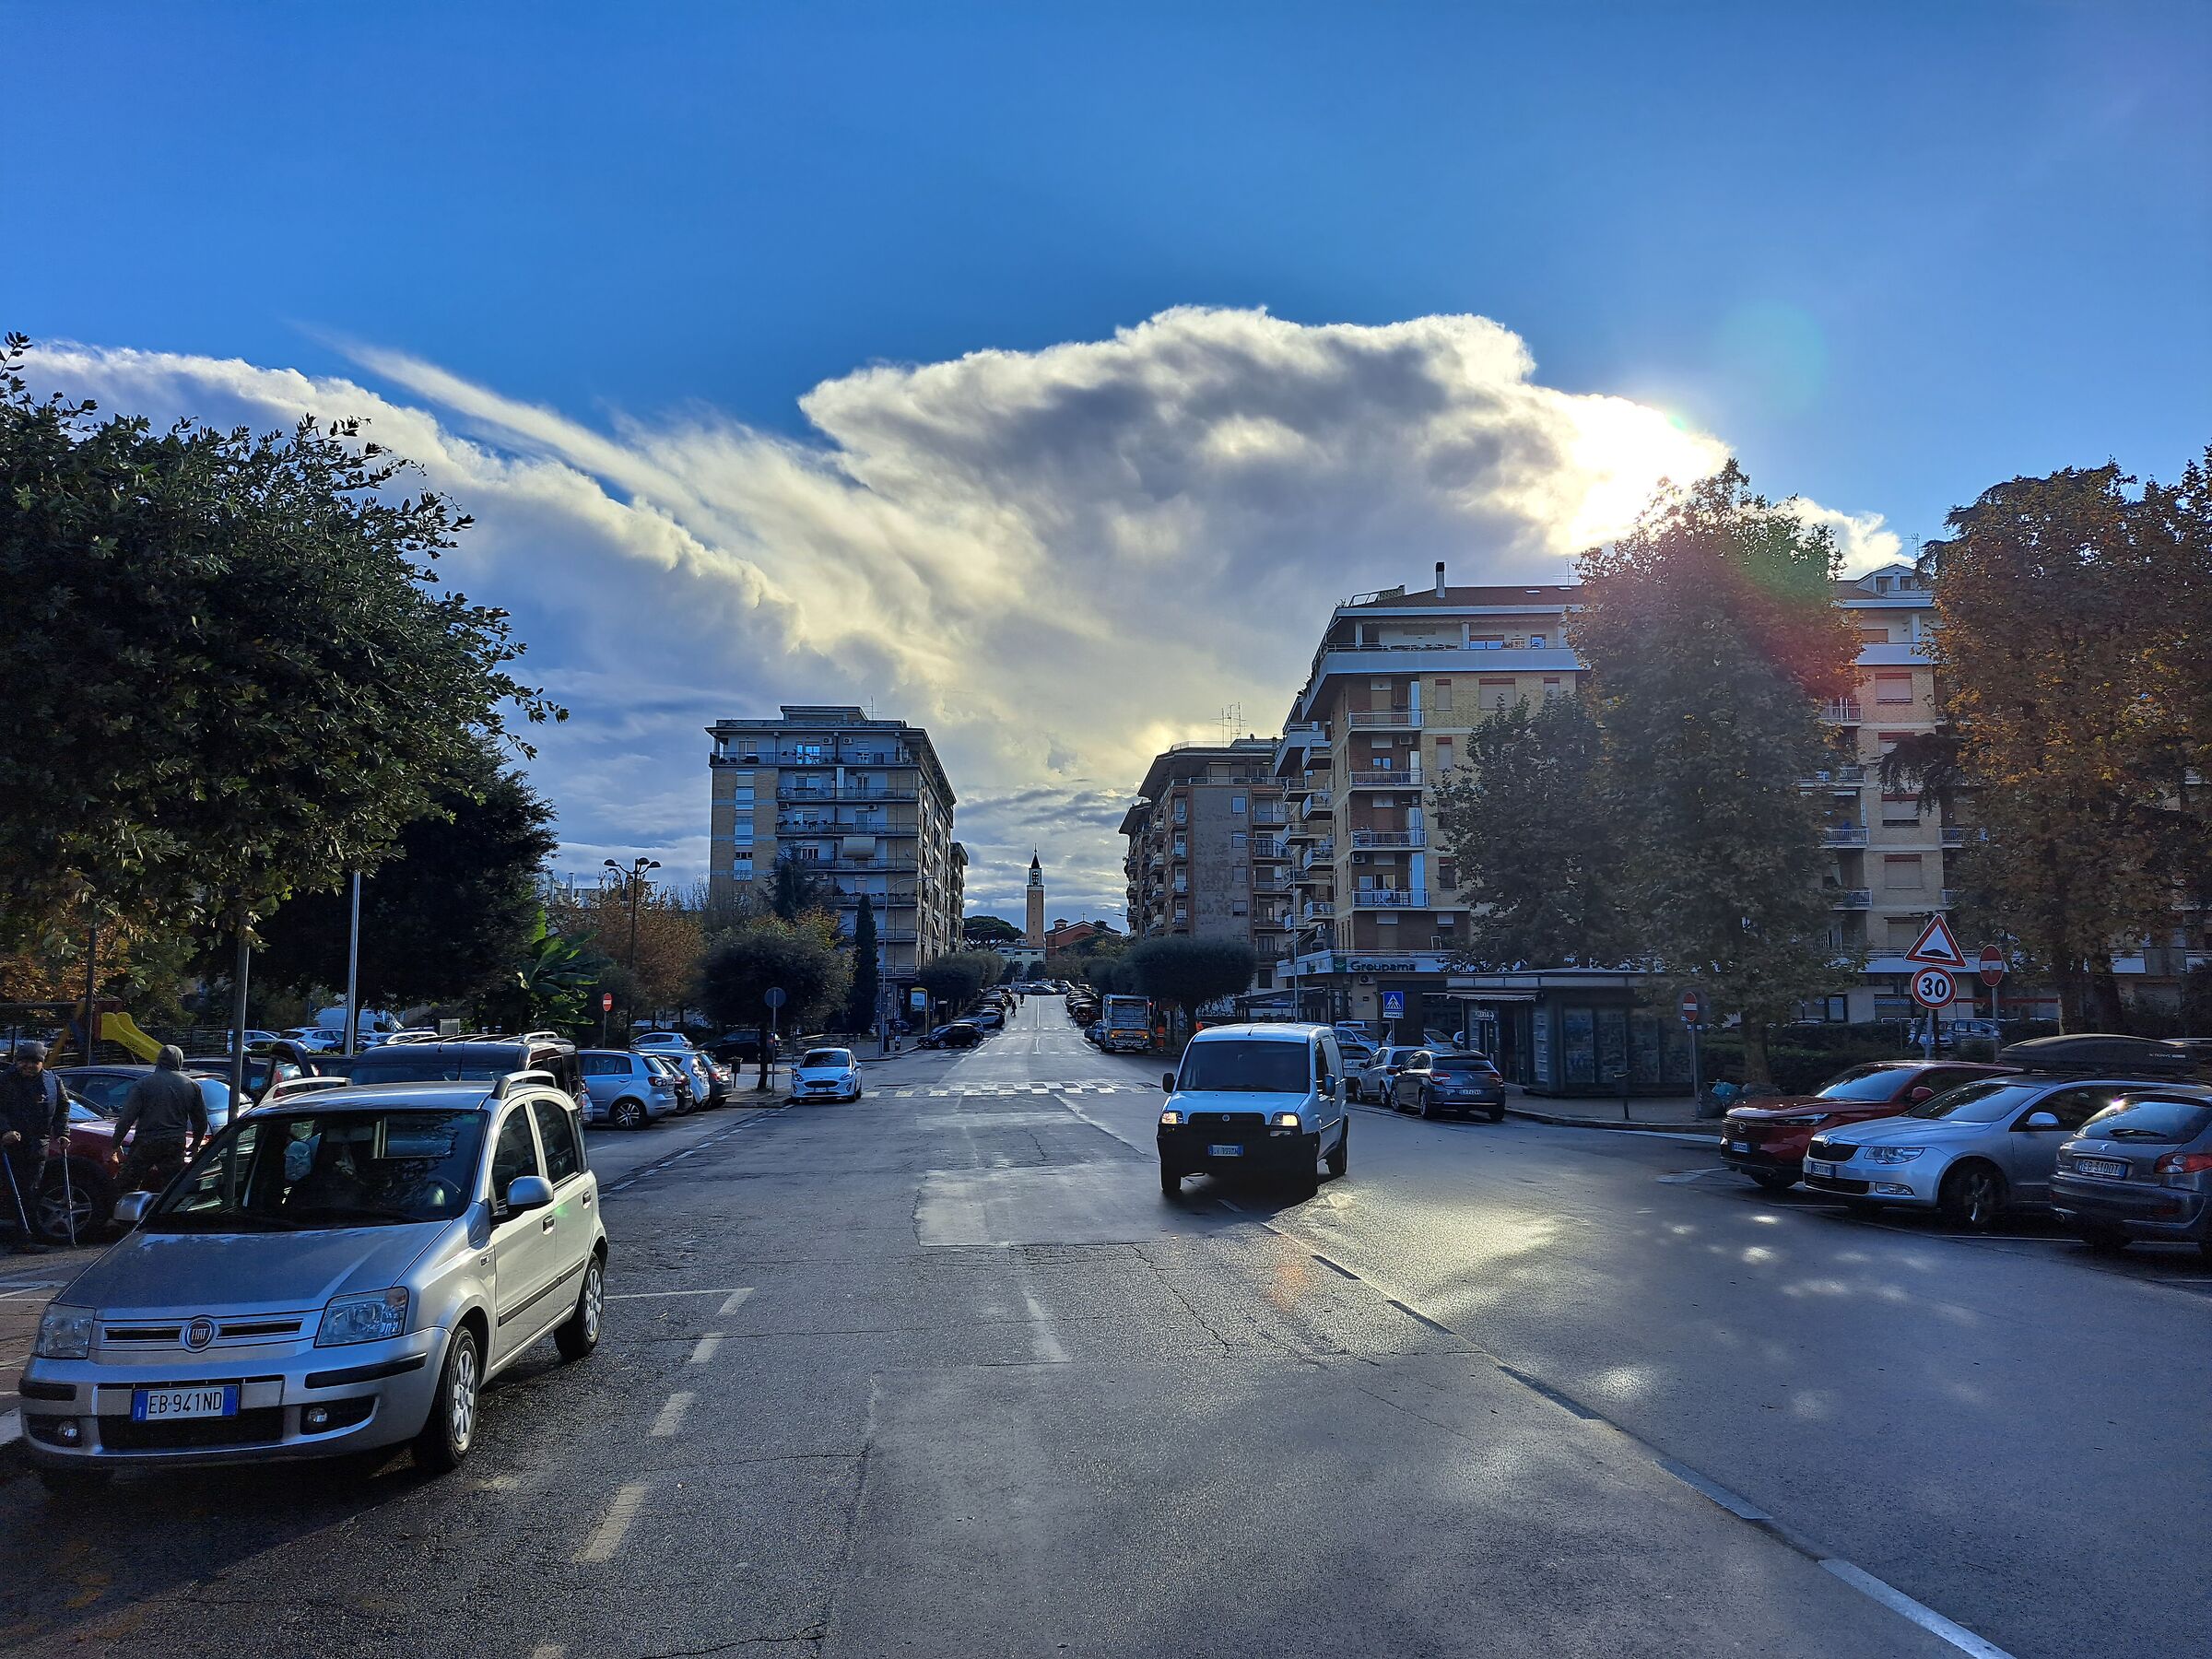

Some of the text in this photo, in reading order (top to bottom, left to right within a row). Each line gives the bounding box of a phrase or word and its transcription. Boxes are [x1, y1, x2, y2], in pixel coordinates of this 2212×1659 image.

[1349, 960, 1417, 972] Groupama
[1921, 977, 1947, 998] 30
[191, 1328, 208, 1341] FIAT
